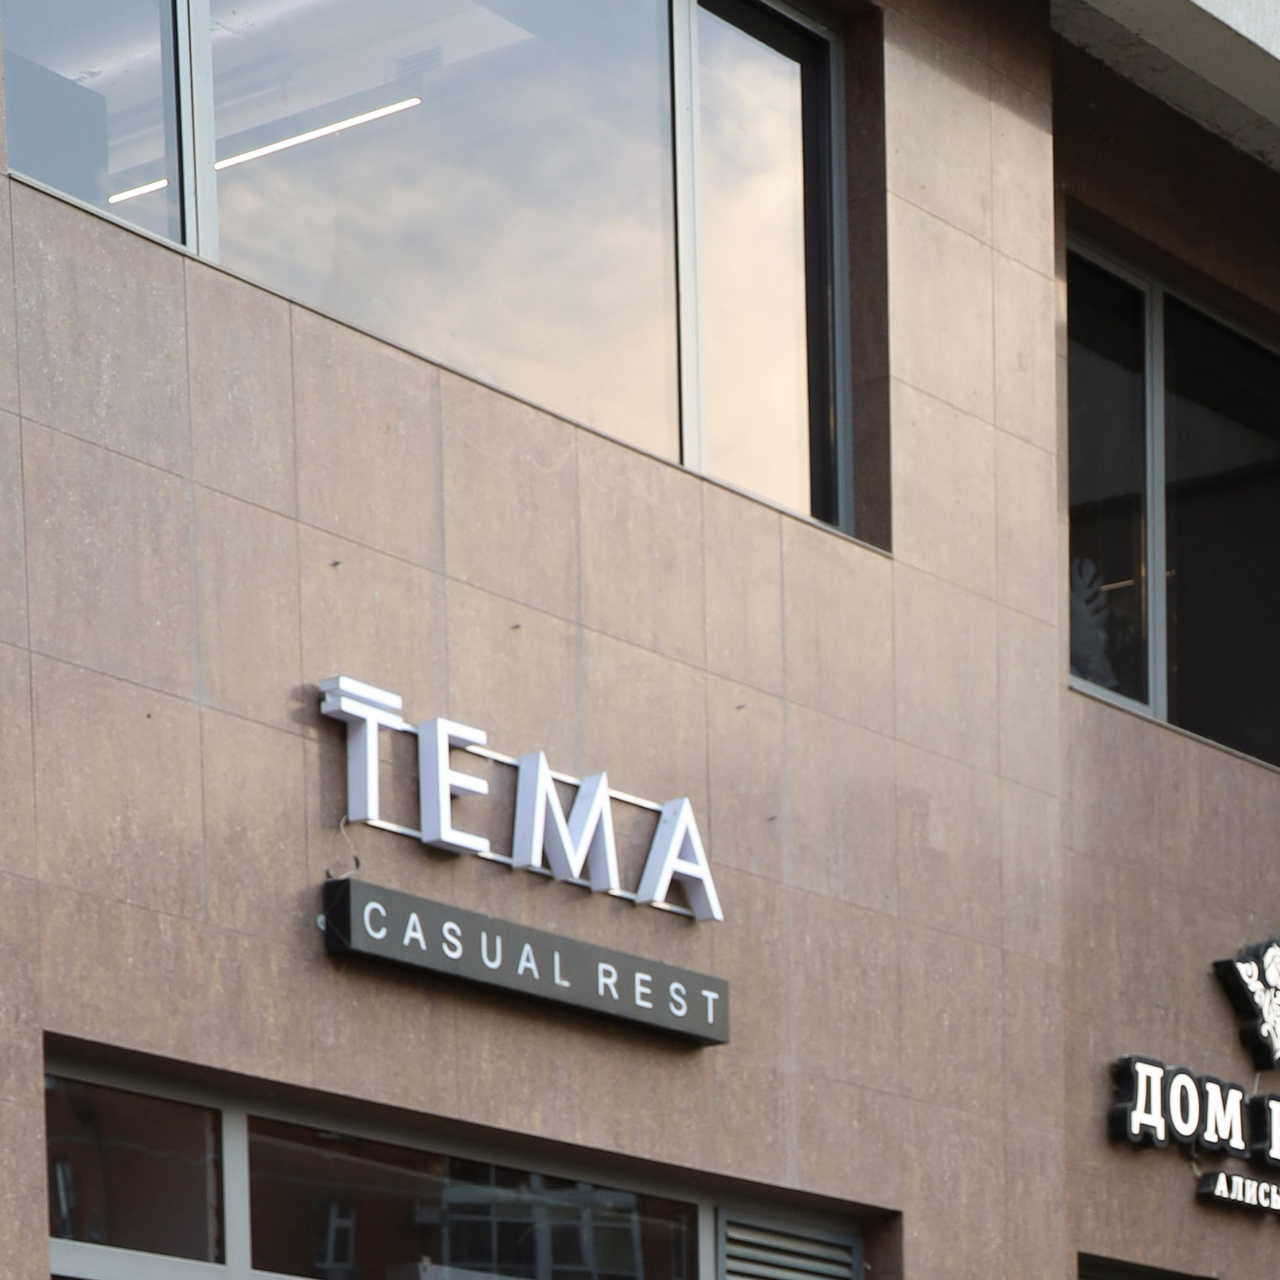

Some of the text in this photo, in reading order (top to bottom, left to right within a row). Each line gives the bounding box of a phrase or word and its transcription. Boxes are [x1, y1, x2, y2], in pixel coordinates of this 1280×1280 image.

[363, 901, 720, 1025] CASUAL REST
[1130, 1061, 1247, 1151] ДОМ
